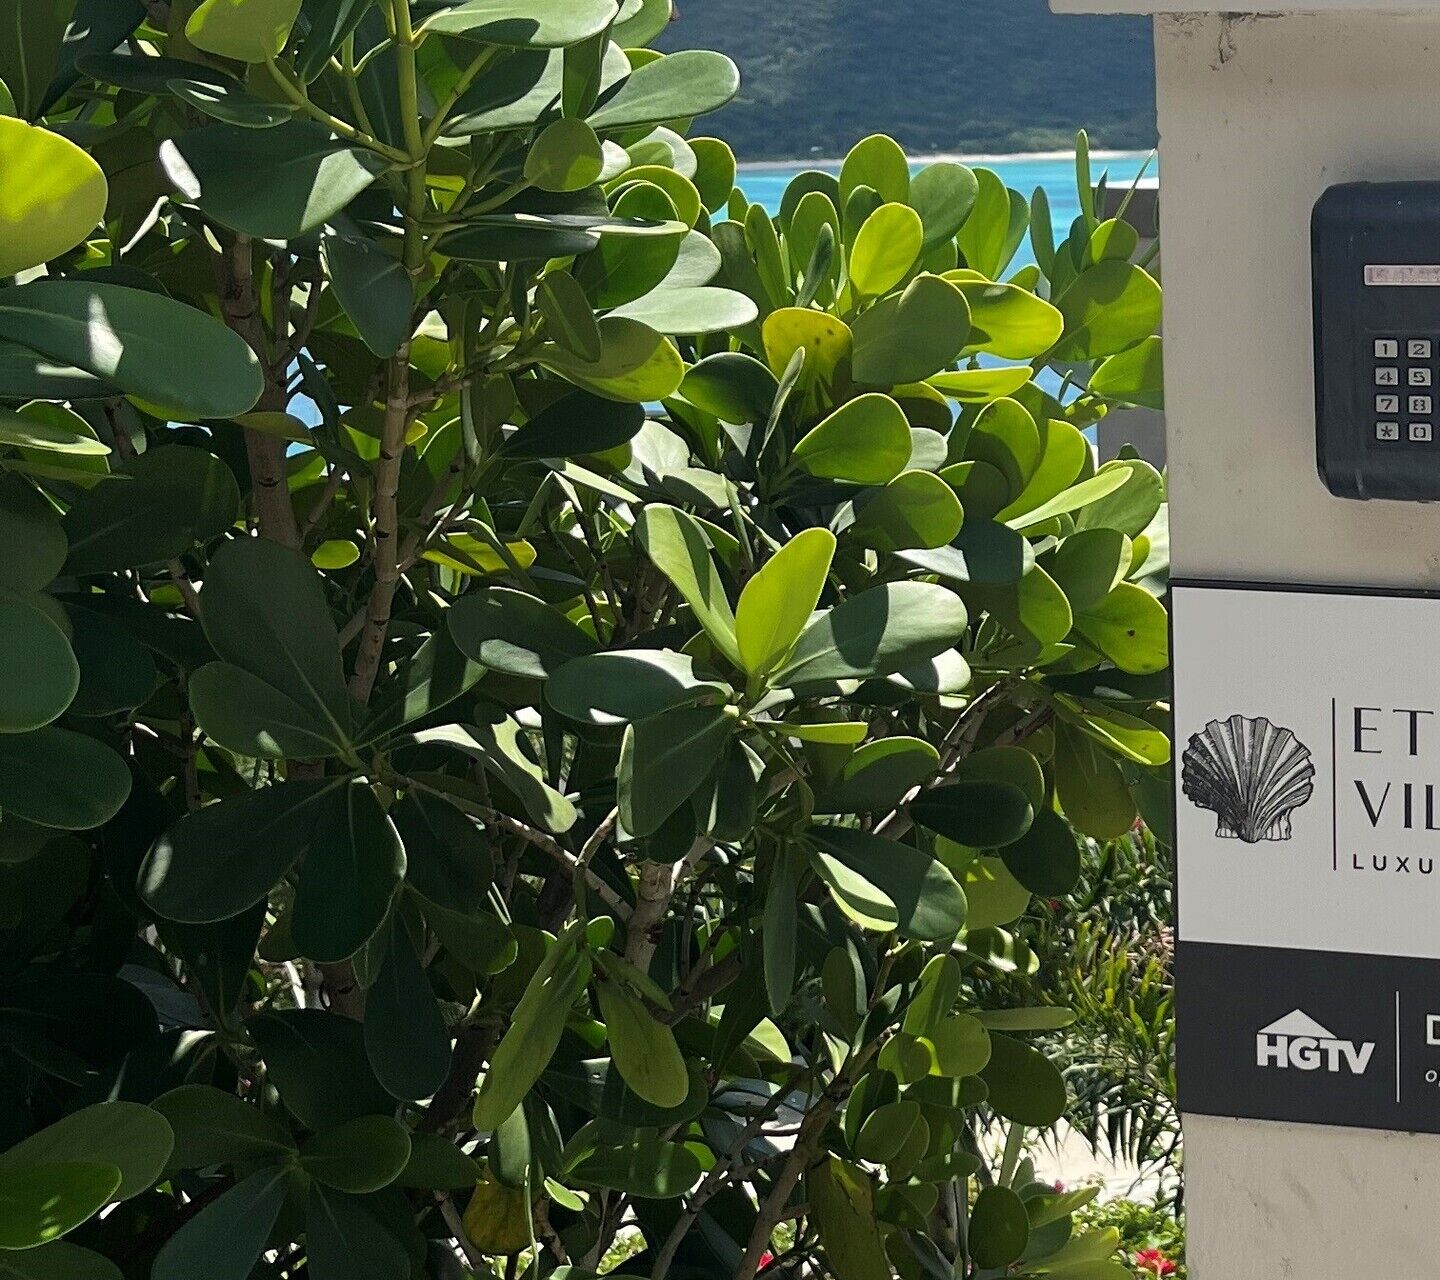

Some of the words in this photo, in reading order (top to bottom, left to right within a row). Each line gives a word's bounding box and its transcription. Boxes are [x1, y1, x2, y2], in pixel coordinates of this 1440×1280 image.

[1413, 343, 1426, 356] 2
[1379, 371, 1393, 383] 4
[1413, 371, 1426, 383] 5
[1380, 398, 1393, 410] 7
[1413, 399, 1427, 412] 8
[1413, 426, 1427, 439] 0
[1257, 1032, 1375, 1073] HGTV
